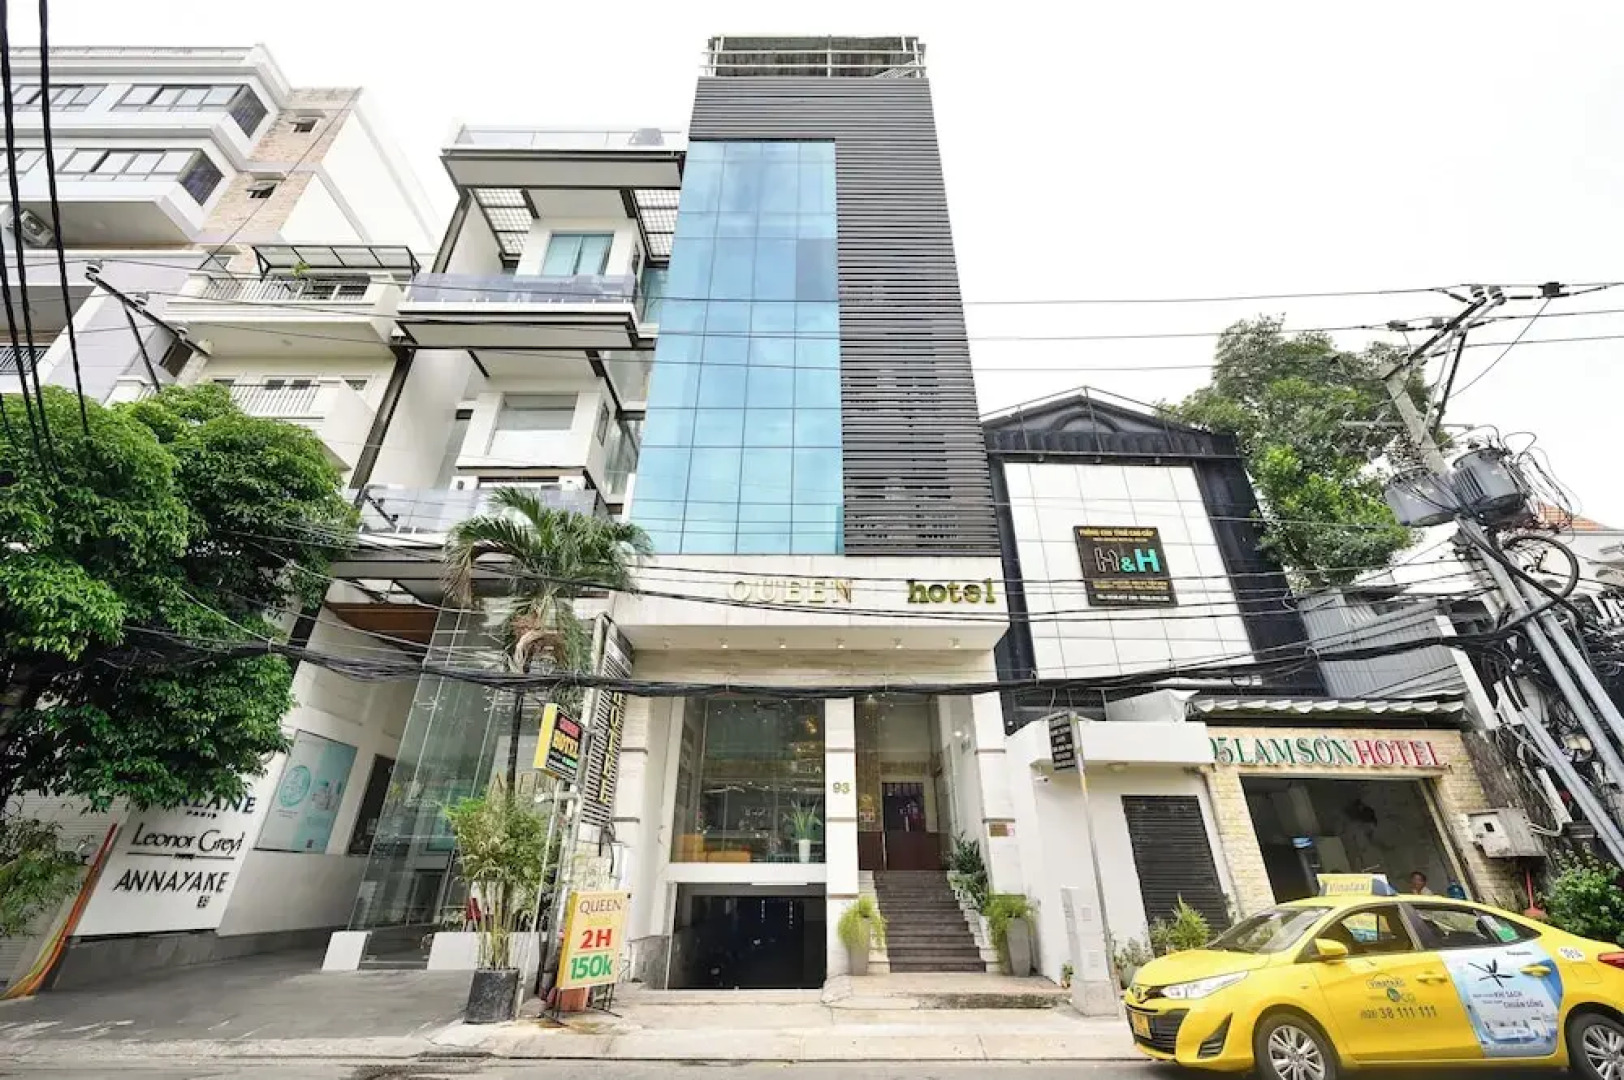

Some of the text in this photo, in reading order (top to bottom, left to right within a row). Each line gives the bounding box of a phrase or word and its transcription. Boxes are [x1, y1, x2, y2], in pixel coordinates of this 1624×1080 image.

[907, 578, 996, 604] hotel
[1353, 741, 1448, 766] HOTEL
[832, 782, 851, 794] 93
[131, 822, 196, 849] Leonor
[113, 868, 230, 893] ANNAYAKE
[580, 899, 623, 915] QUEEN
